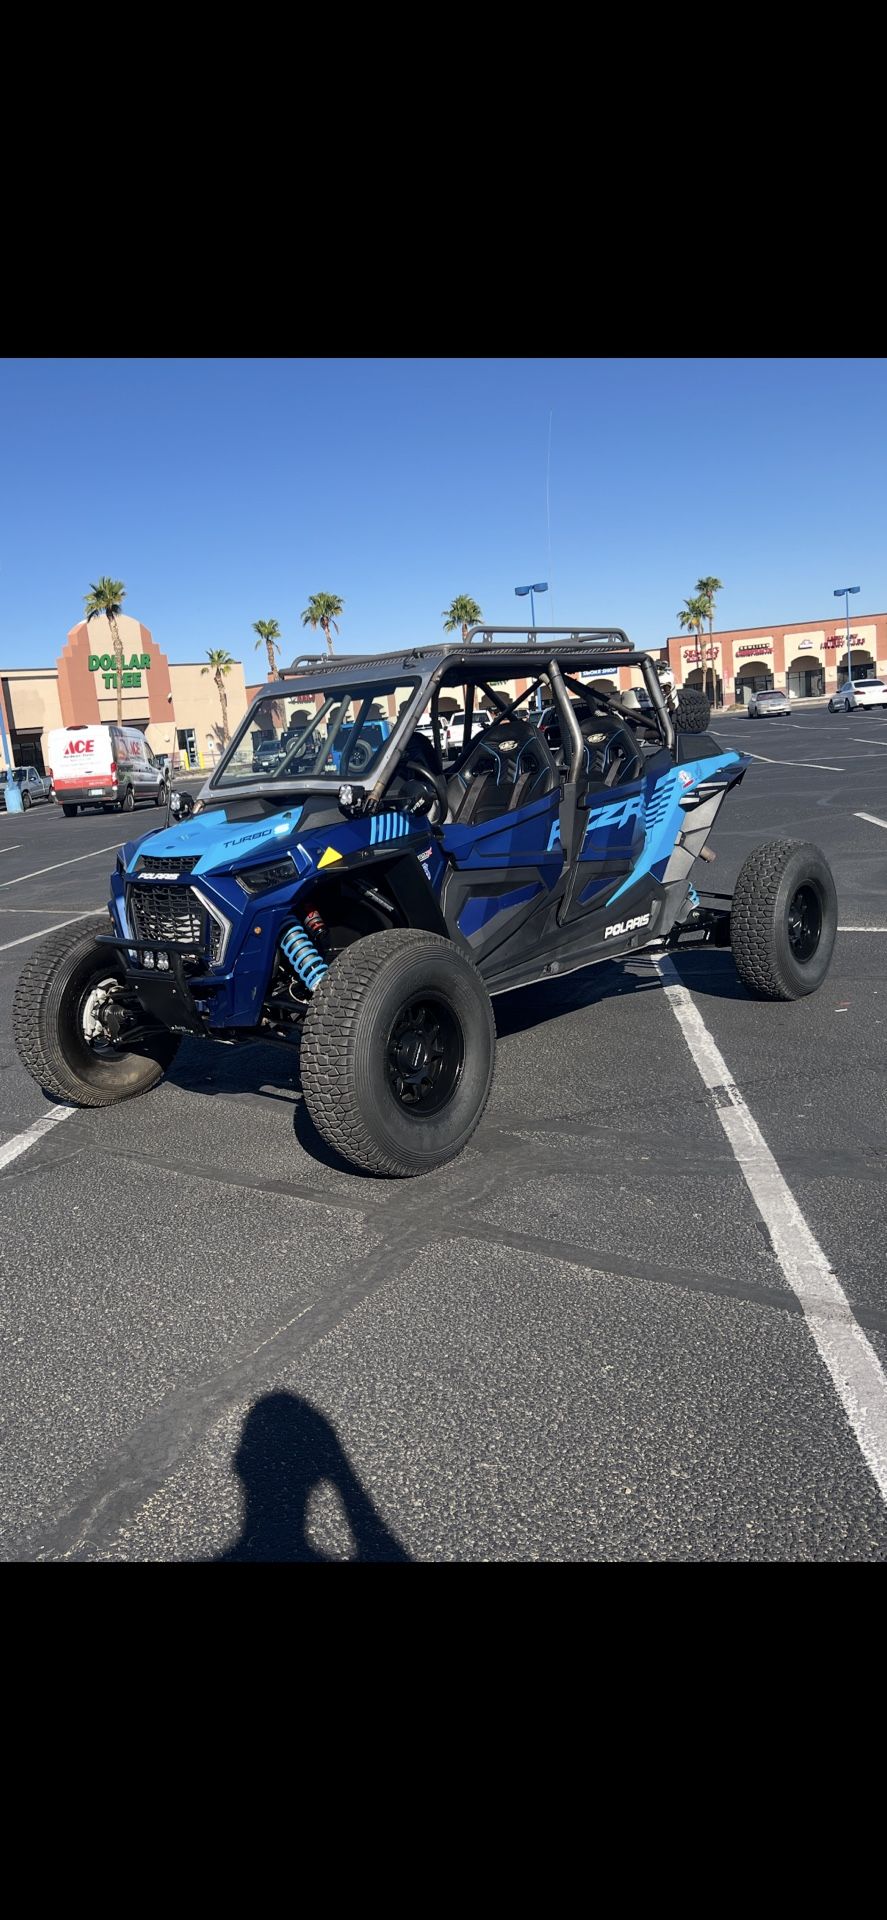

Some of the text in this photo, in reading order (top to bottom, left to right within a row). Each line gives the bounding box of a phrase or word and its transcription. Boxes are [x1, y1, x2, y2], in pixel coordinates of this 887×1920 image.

[88, 653, 151, 671] DOLLAR
[64, 739, 95, 755] ACE
[223, 829, 273, 848] TURBO
[137, 872, 180, 880] POLARIS
[604, 913, 650, 939] POLARIS
